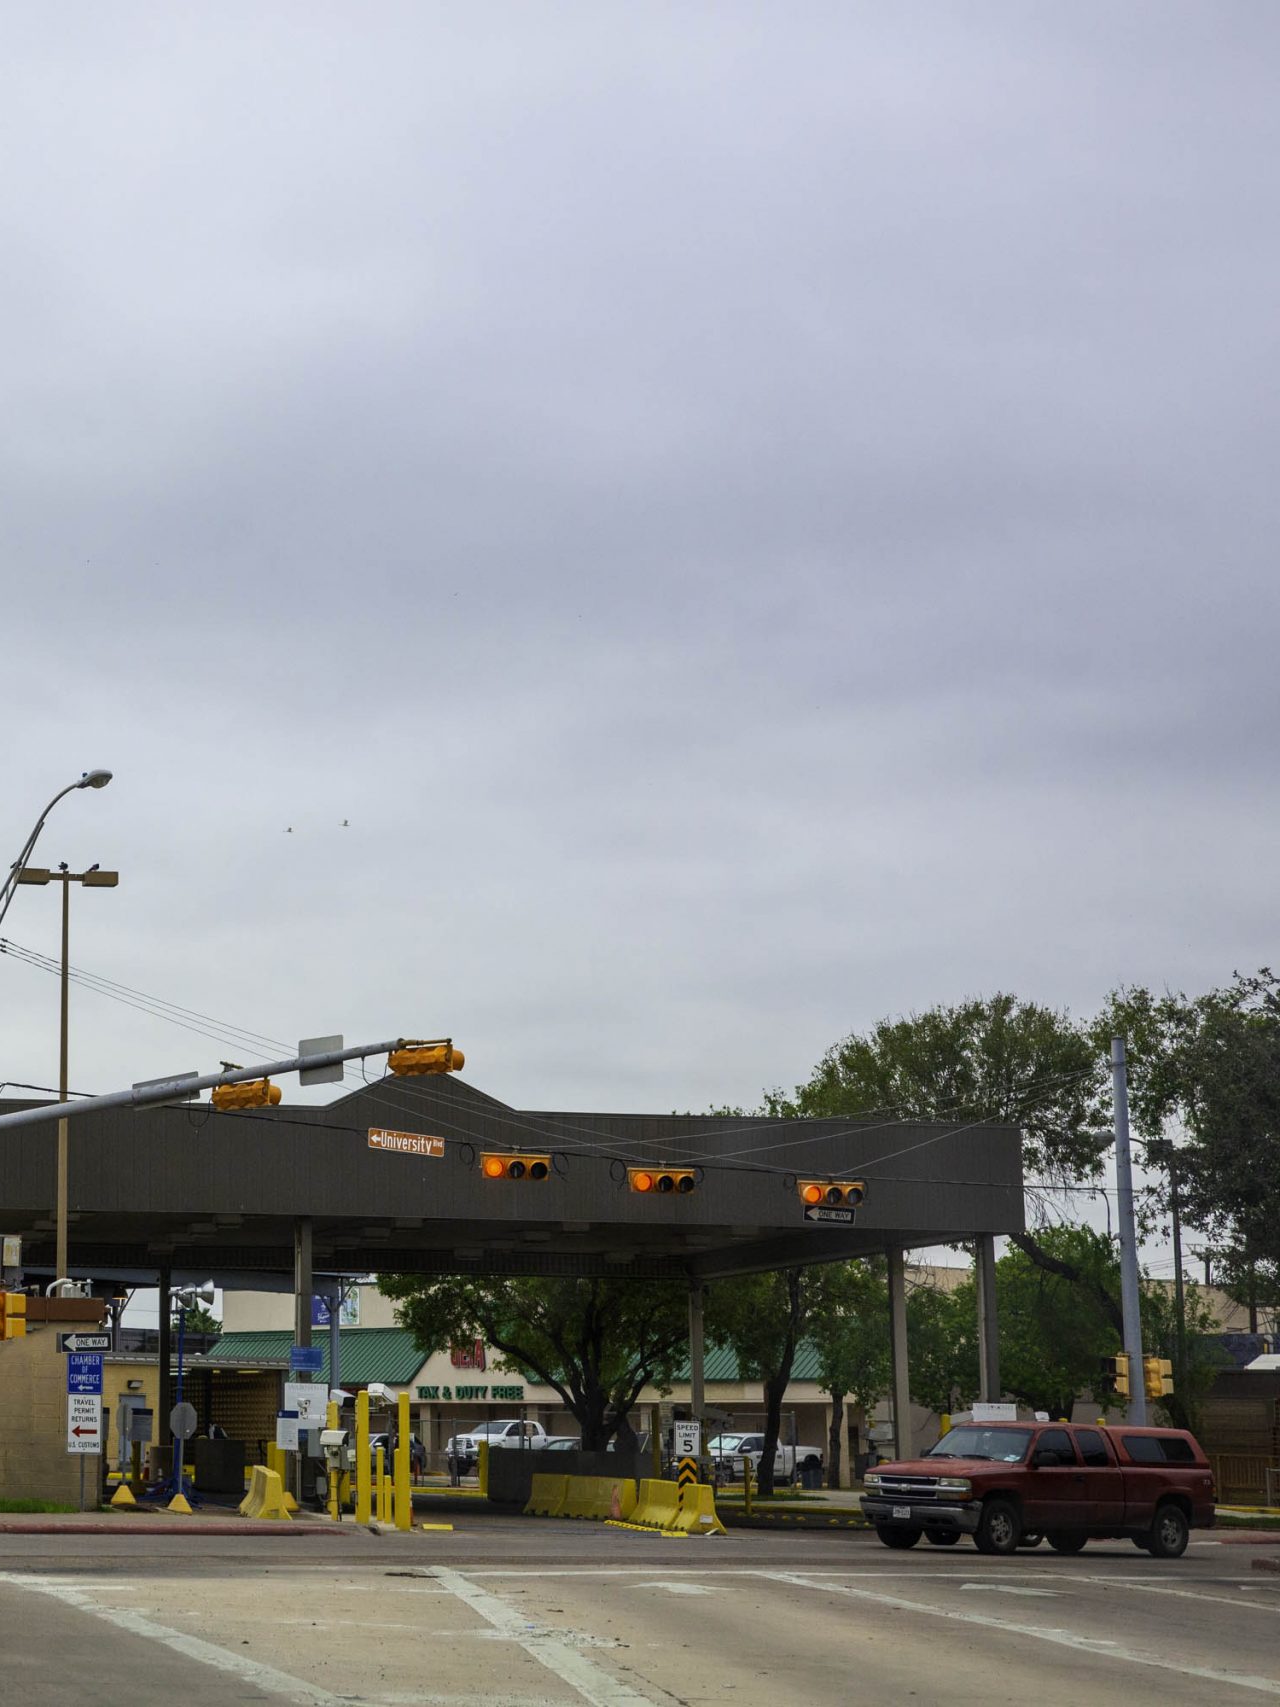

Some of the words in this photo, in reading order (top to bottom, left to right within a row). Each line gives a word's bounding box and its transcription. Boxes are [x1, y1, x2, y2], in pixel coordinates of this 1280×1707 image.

[381, 1131, 432, 1155] University
[433, 1138, 443, 1148] Blvd
[819, 1210, 833, 1218] ONE
[75, 1338, 90, 1347] ONE
[91, 1338, 106, 1347] WAY
[71, 1355, 100, 1366] CHAMBER
[81, 1365, 88, 1373] OF
[70, 1374, 100, 1384] COMMERCE
[416, 1386, 440, 1399] TAX
[442, 1386, 452, 1400] &
[455, 1386, 488, 1399] DUTY
[491, 1386, 524, 1400] FREE
[78, 1441, 100, 1449] CUSTOMS
[683, 1440, 693, 1452] 5
